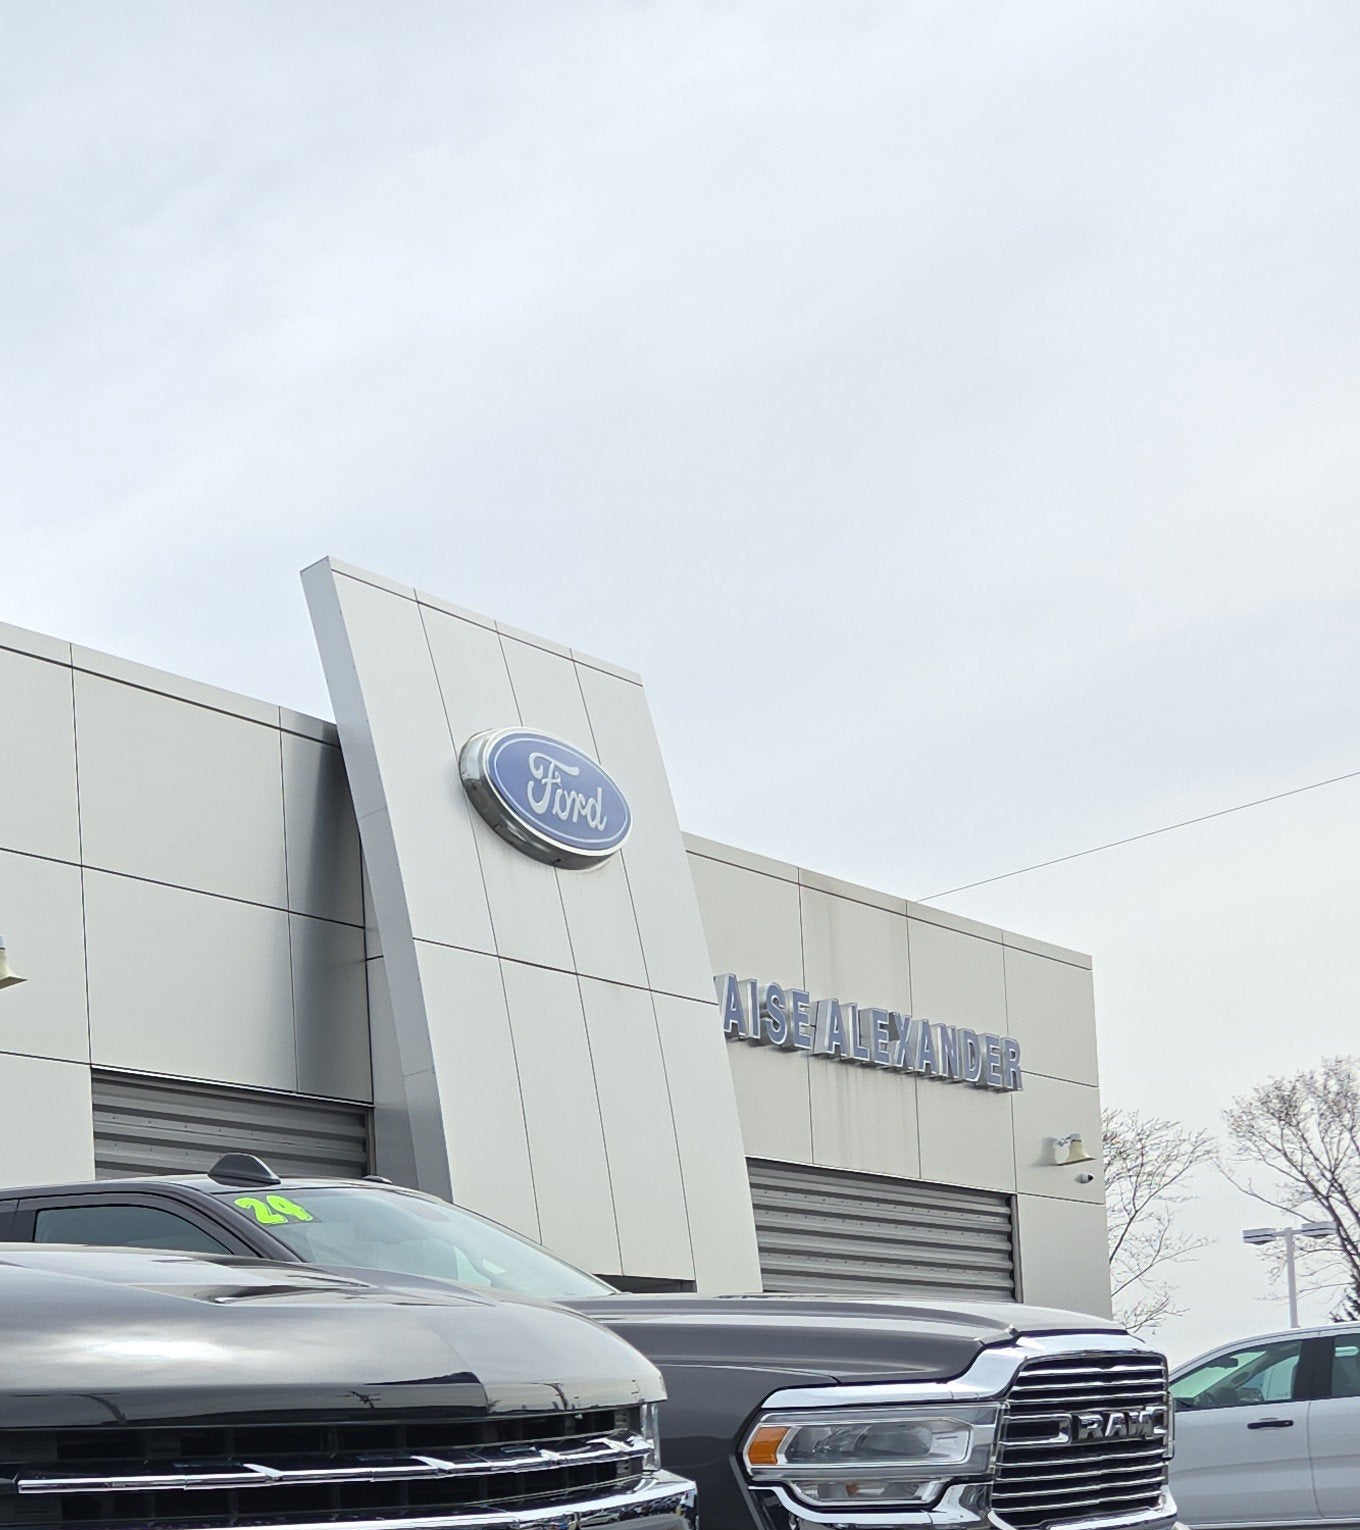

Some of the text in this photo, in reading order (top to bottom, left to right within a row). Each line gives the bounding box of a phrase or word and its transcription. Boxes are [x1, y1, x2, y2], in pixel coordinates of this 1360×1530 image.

[527, 752, 607, 831] Ford
[817, 998, 1024, 1091] ALEXANDER
[1078, 1408, 1154, 1440] RAM
